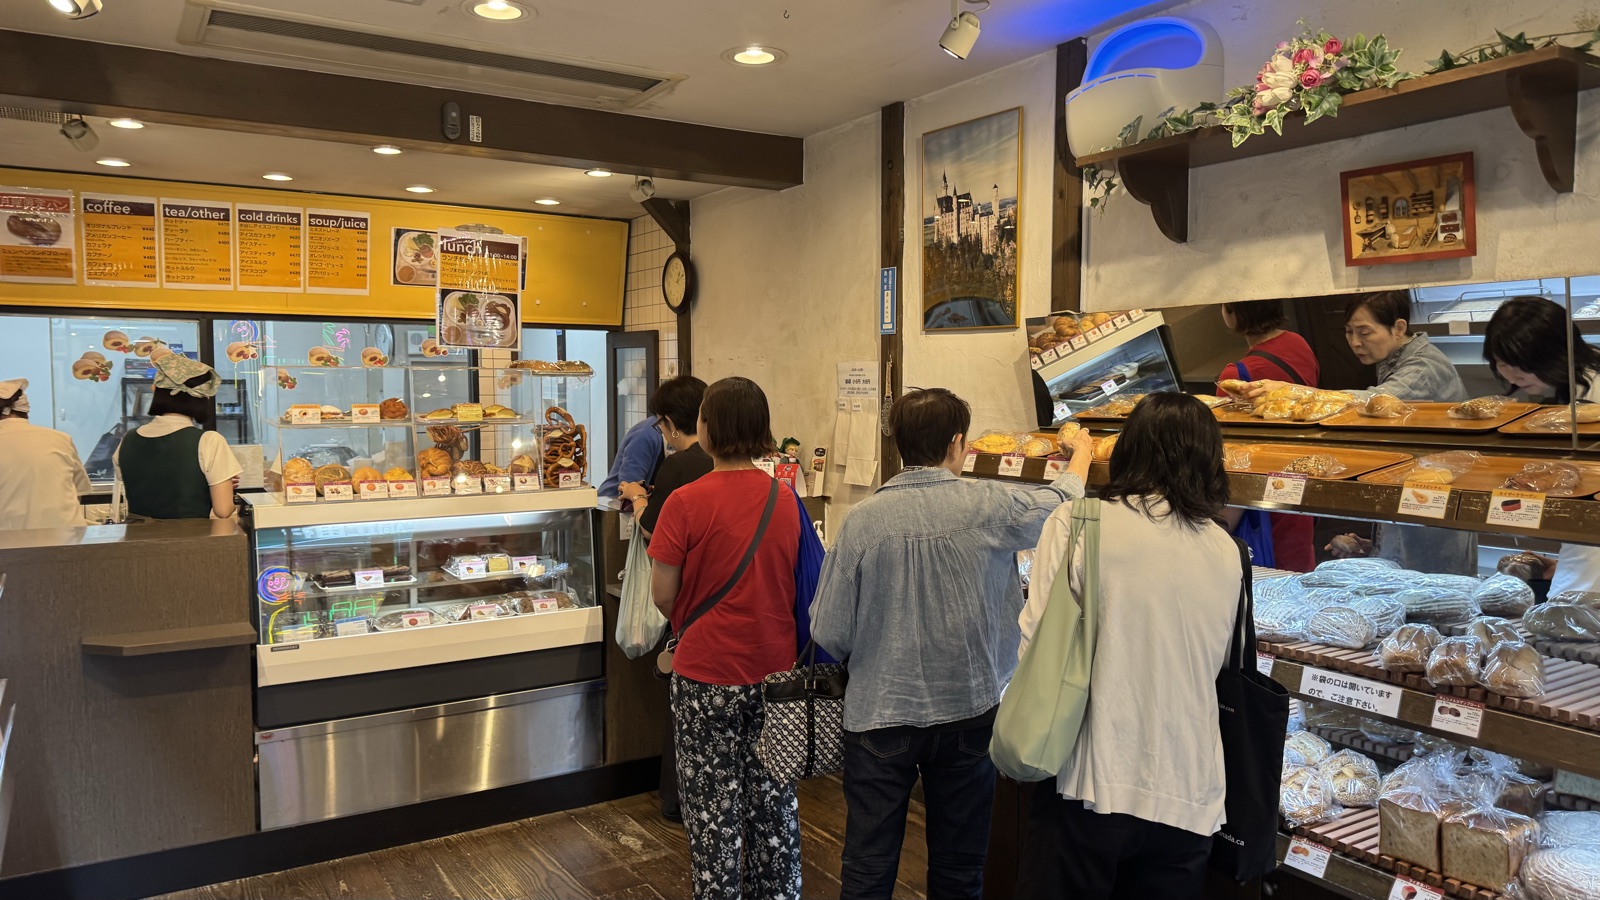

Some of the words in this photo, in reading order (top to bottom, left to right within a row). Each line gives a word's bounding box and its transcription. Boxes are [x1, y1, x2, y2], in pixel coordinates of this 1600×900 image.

[86, 199, 131, 214] coffee
[164, 206, 226, 220] tea/other
[240, 211, 263, 222] cold
[265, 212, 298, 224] drinks
[310, 217, 366, 230] soup/juice
[86, 232, 133, 240] アメリカンコーヒー
[239, 231, 276, 239] アイスカフェラテ
[443, 238, 482, 254] lunch
[1311, 673, 1392, 699] ※袋の口は開いています
